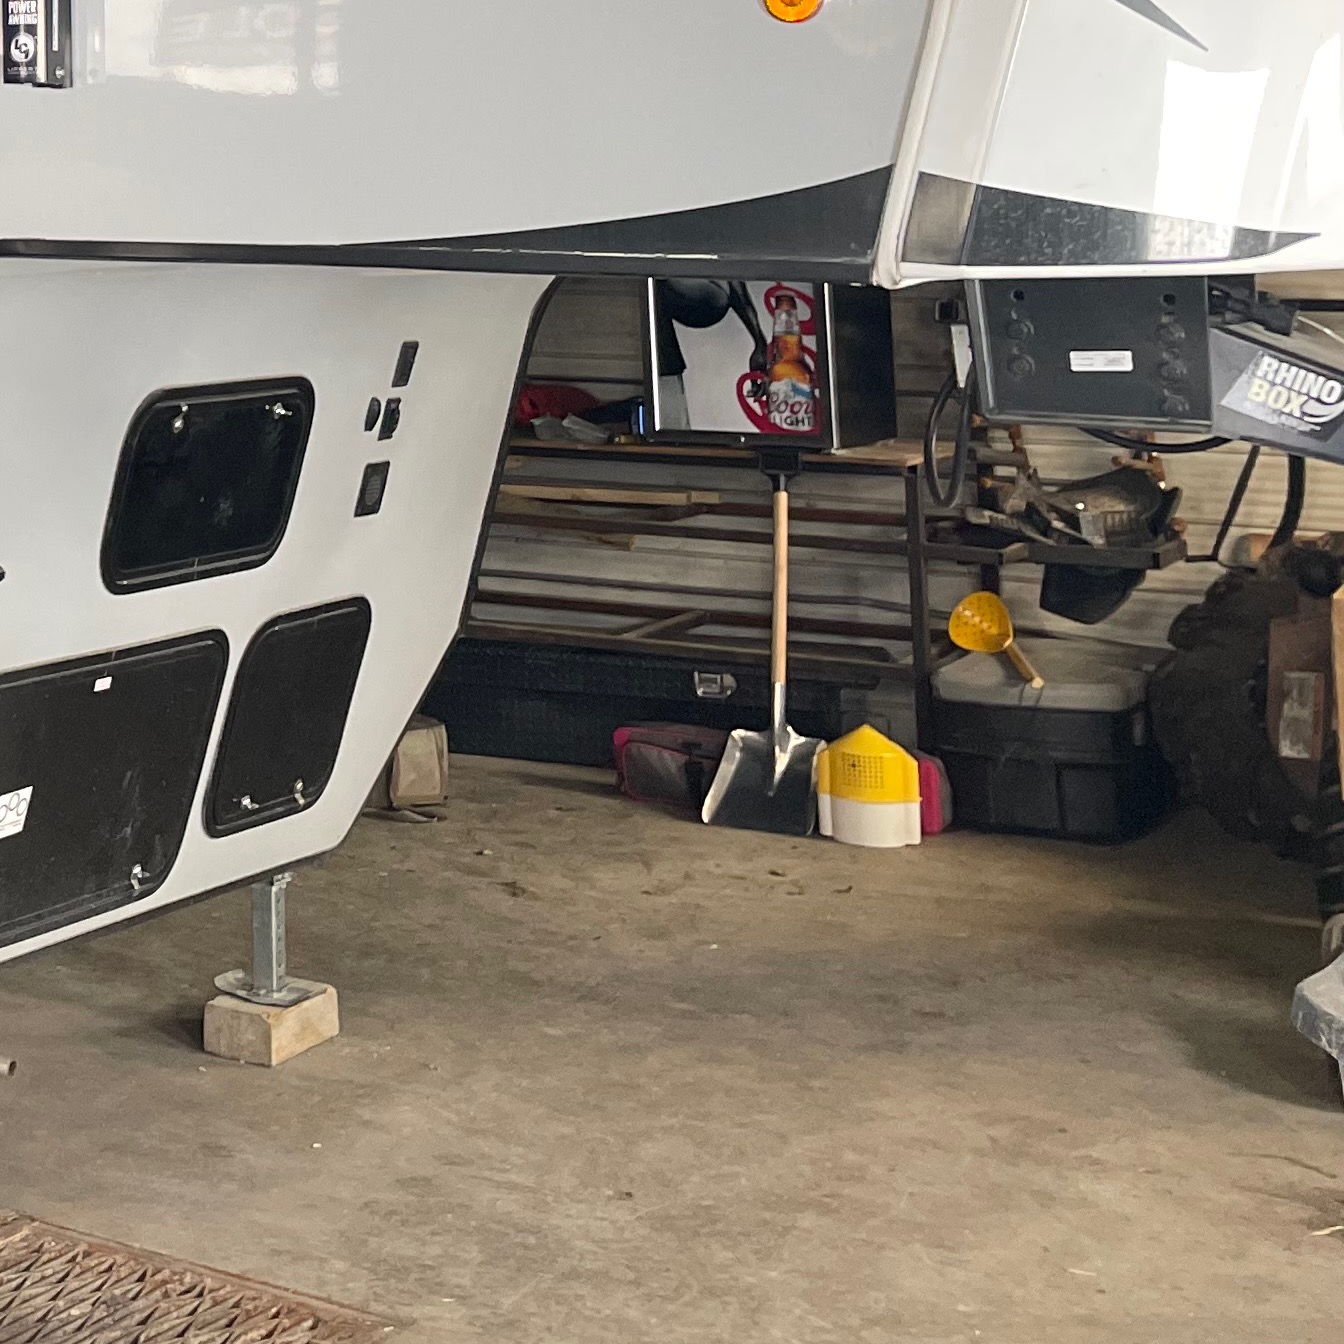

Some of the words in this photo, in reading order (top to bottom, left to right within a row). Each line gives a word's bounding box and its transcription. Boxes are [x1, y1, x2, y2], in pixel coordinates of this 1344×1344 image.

[8, 0, 38, 15] POWER
[1247, 377, 1310, 418] BOX
[1256, 355, 1342, 405] RHINO
